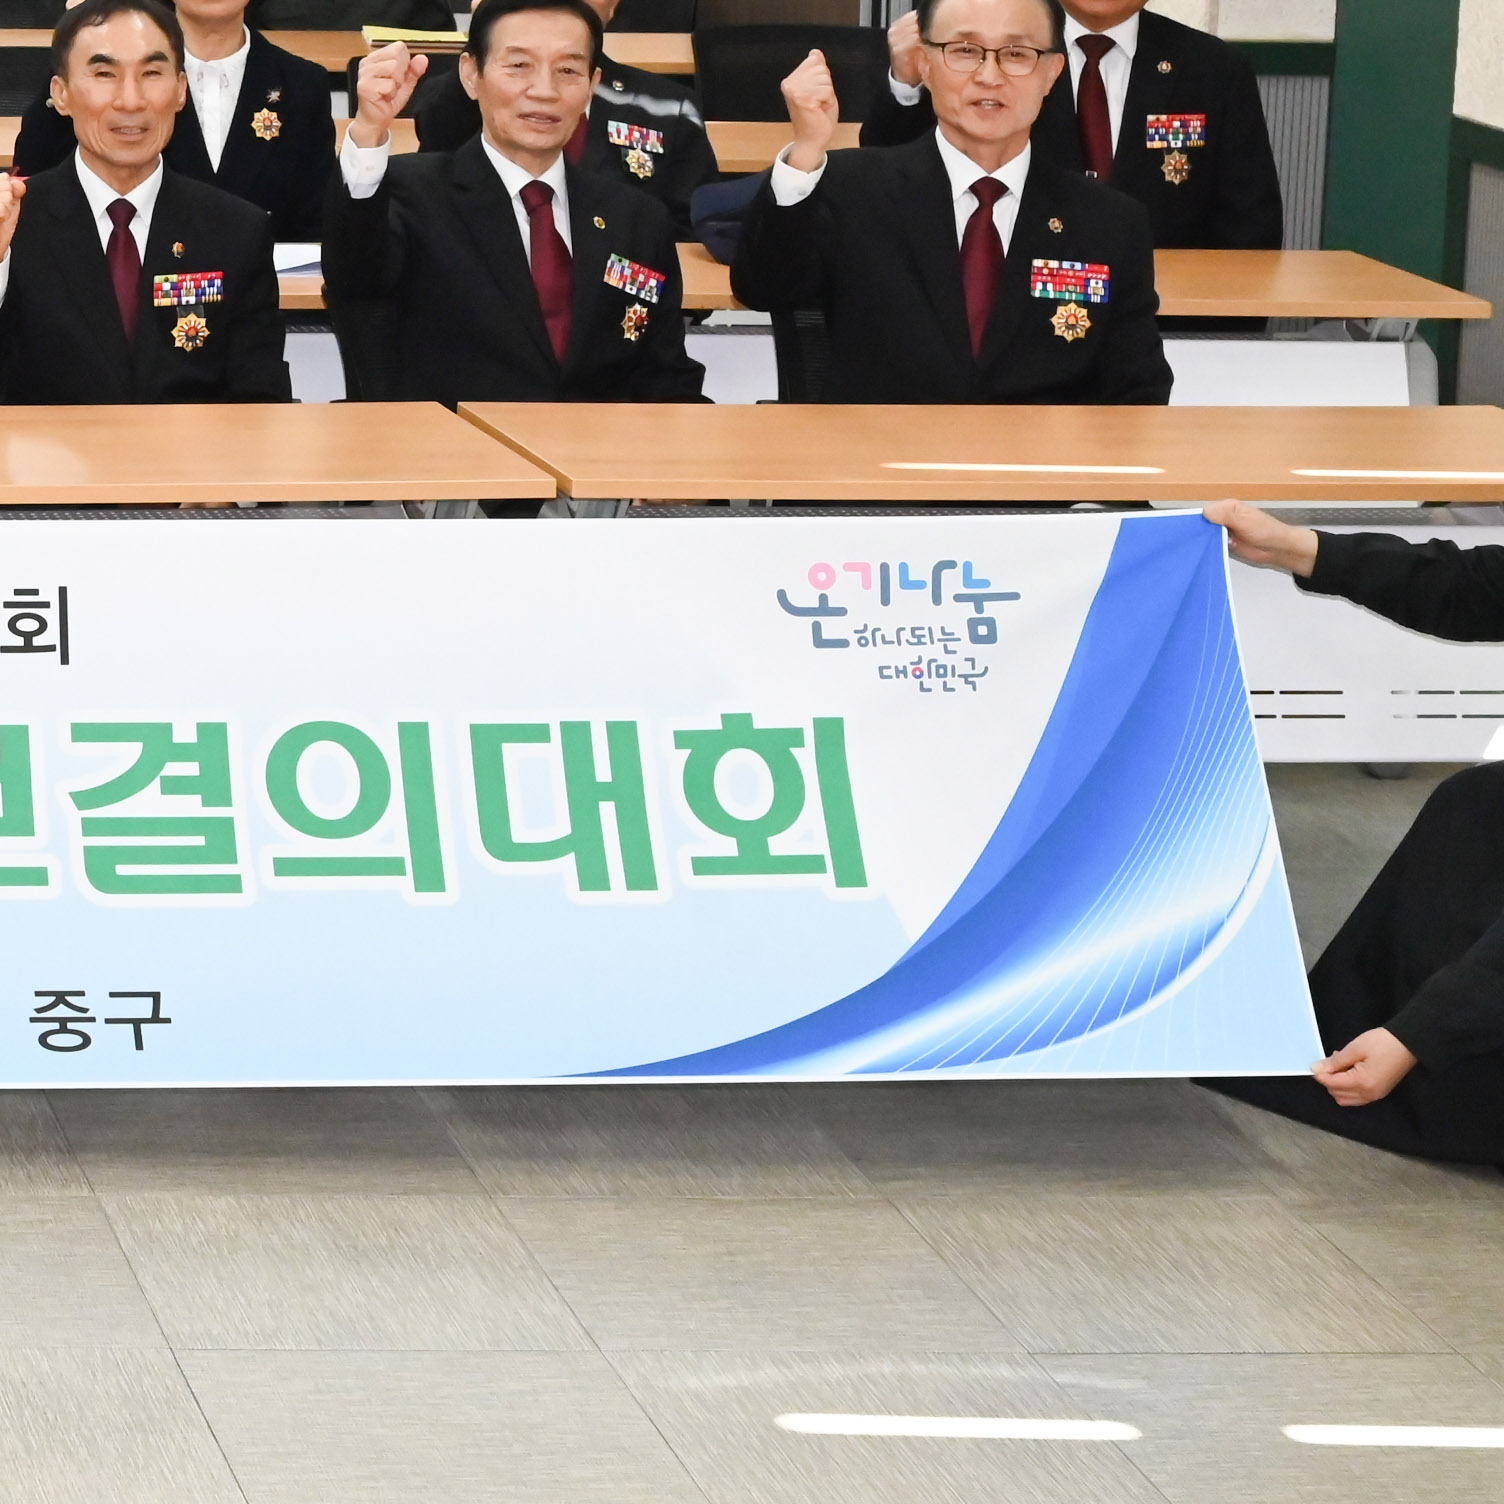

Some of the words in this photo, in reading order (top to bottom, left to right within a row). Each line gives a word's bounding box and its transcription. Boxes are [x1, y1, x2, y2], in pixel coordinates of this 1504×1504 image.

[776, 559, 1022, 649] 온기나눔
[853, 623, 963, 655] 하나되는
[878, 655, 990, 693] 대한민국
[28, 989, 173, 1054] 중구
